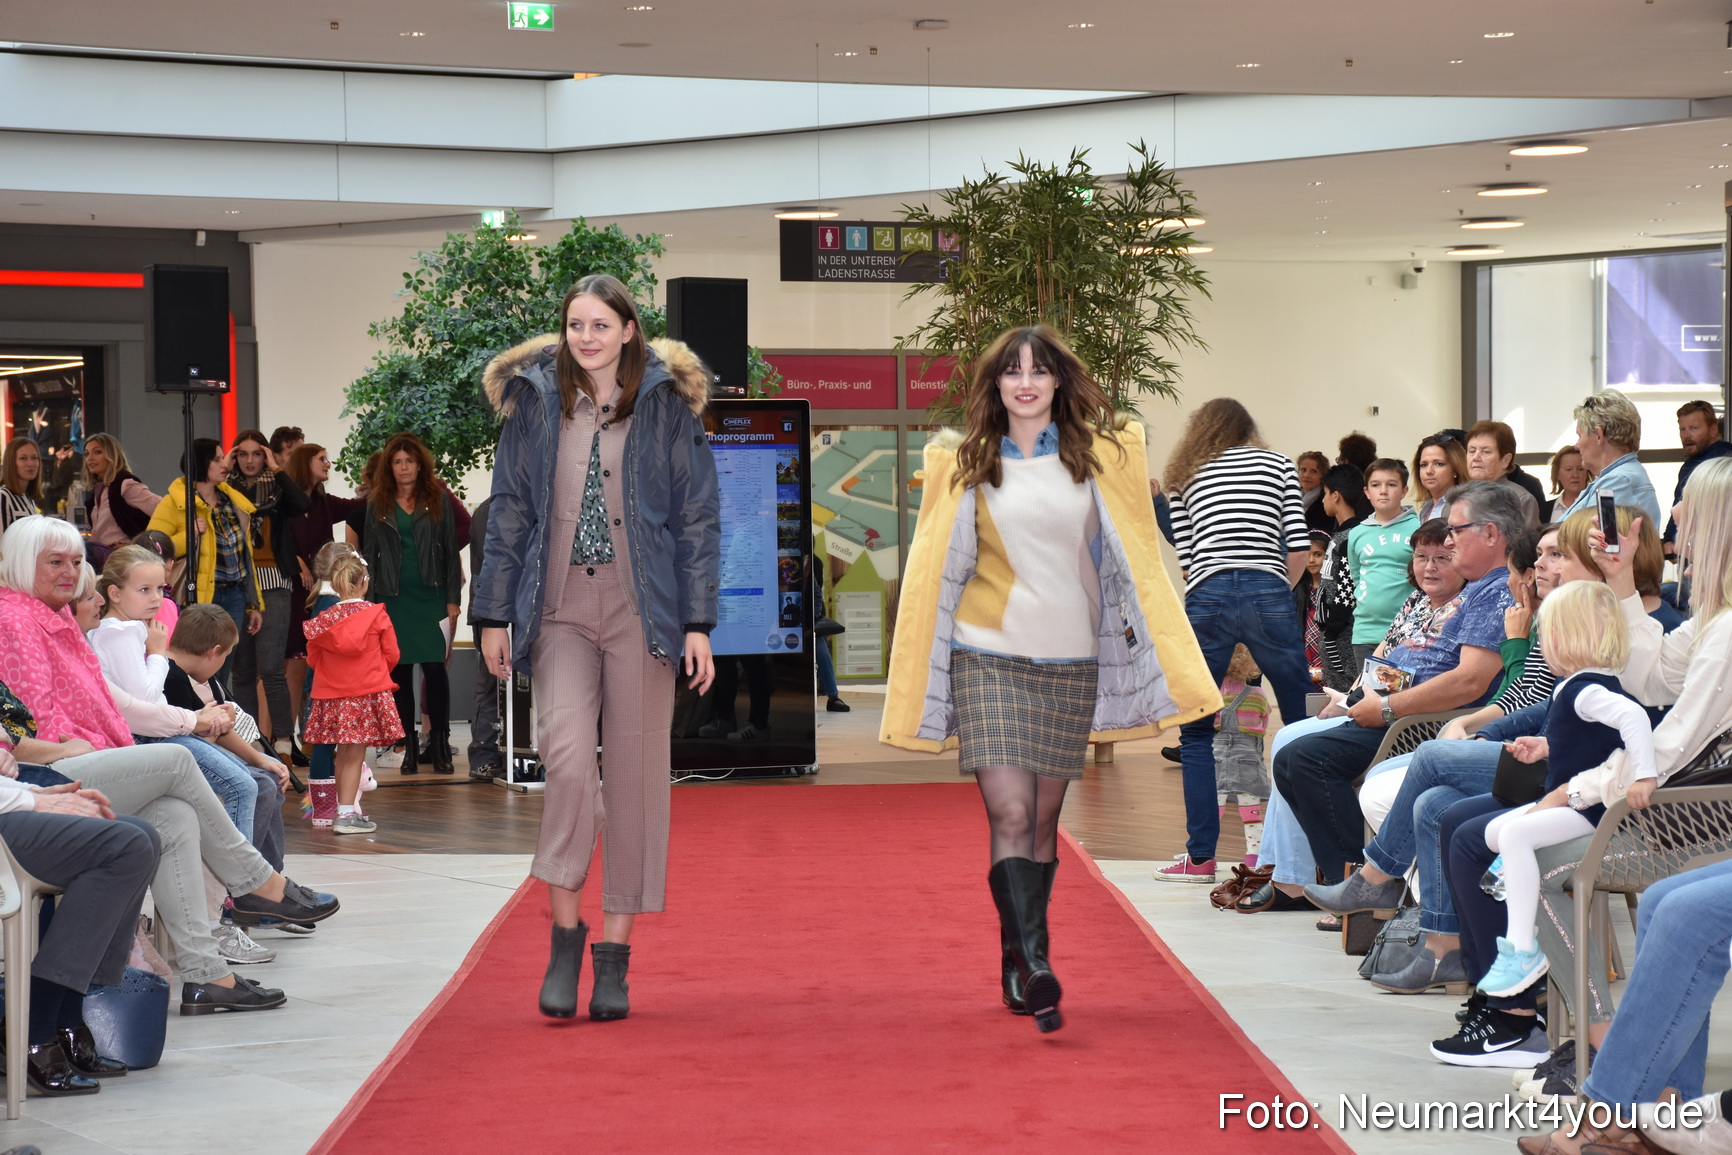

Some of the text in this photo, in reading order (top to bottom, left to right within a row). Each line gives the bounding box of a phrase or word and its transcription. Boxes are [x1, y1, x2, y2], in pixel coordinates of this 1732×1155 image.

[818, 255, 896, 266] IN DER UNTEREN
[818, 268, 896, 279] LADENSTRASSE
[787, 379, 816, 391] Büro-,
[818, 379, 851, 390] Praxis-
[853, 379, 872, 390] und
[723, 417, 752, 426] CINEPLEX
[708, 432, 775, 443] inoprogramm
[811, 444, 820, 453] eg
[831, 541, 853, 558] Straße
